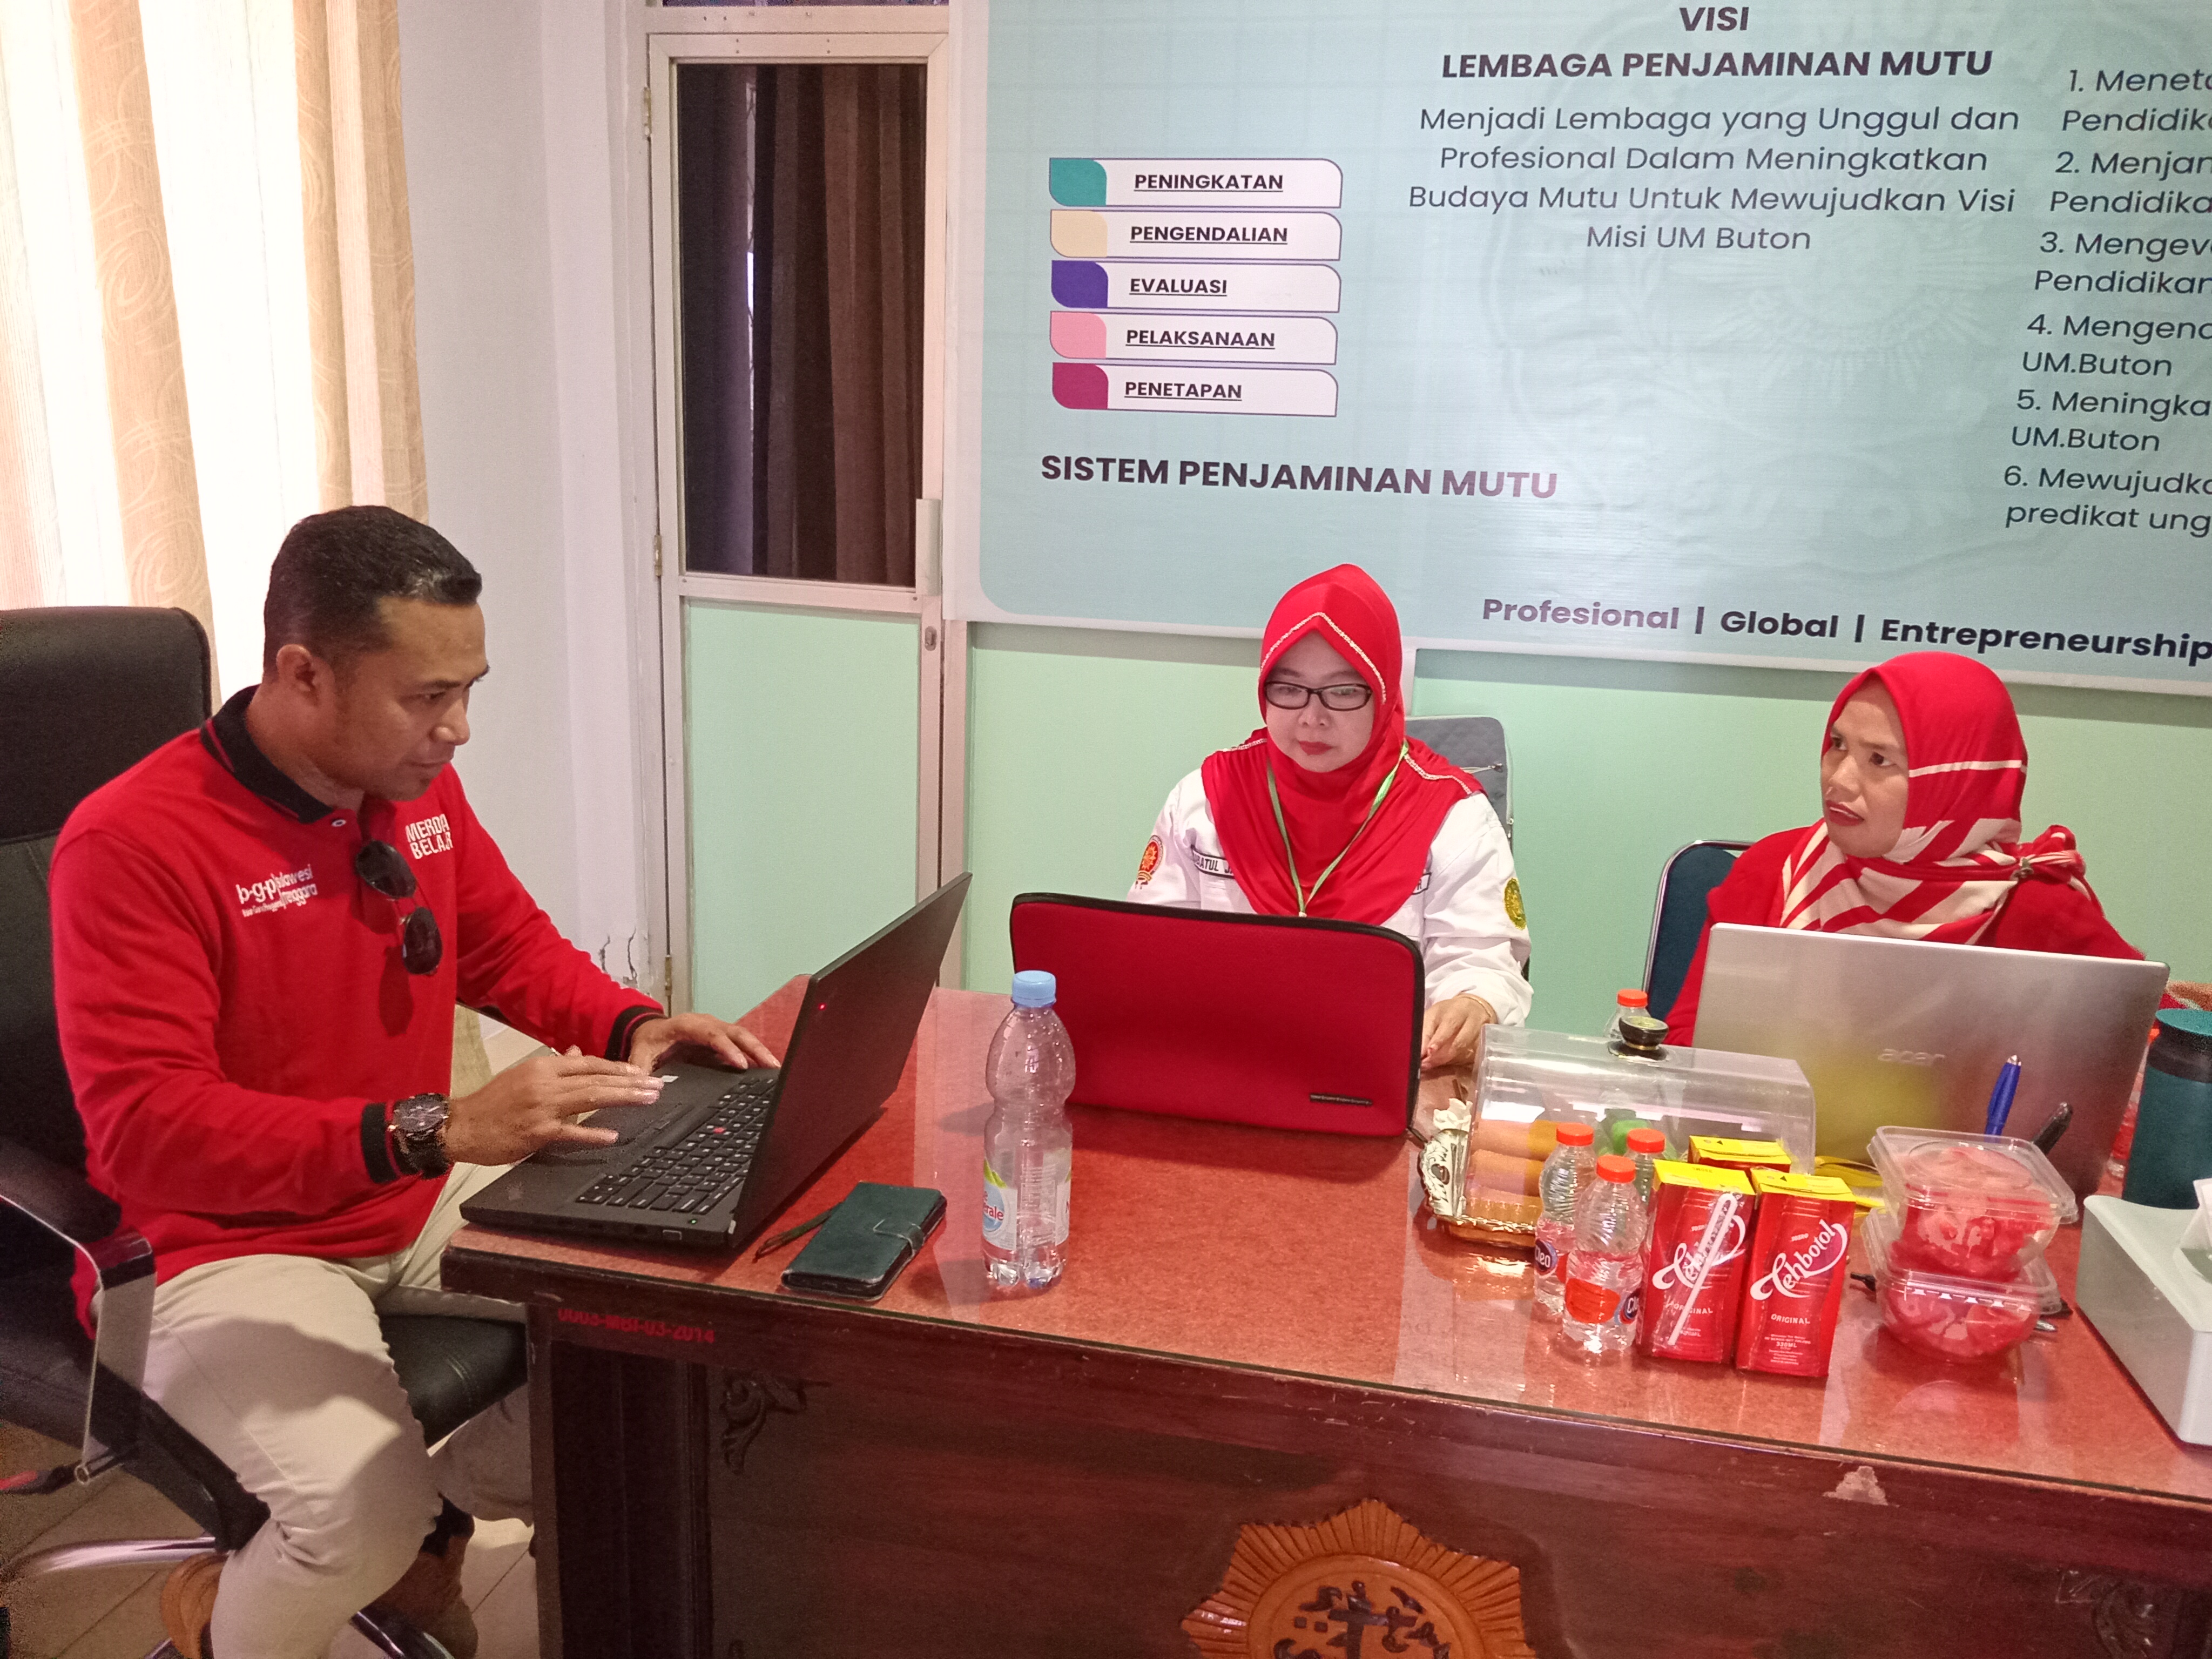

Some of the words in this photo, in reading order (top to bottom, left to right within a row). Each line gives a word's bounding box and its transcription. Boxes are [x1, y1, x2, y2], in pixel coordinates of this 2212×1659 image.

[1679, 6, 1749, 31] VISI
[1442, 53, 1612, 78] LEMBAGA
[1622, 51, 1871, 77] PENJAMINAN
[1880, 50, 1993, 76] MUTU
[2069, 69, 2083, 92] 1.
[1420, 106, 1546, 137] Menjadi
[1555, 106, 1711, 138] Lembaga
[1722, 111, 1807, 138] yang
[1819, 106, 1940, 138] Unggul
[1951, 106, 2019, 130] dan
[2062, 107, 2212, 132] Pendidik
[1441, 145, 1616, 169] Profesional
[1626, 146, 1734, 170] Dalam
[1746, 146, 1987, 178] Meningkatkan
[2055, 151, 2080, 173] 2.
[1134, 174, 1283, 193] PENINGKATAN
[1409, 185, 1528, 215] Budaya
[1539, 187, 1618, 208] Mutu
[1629, 186, 1722, 210] Untuk
[1731, 186, 1945, 218] Mewujudkan
[1958, 188, 2015, 212] Visi
[1130, 226, 1287, 245] PENGENDALIAN
[1587, 225, 1647, 248] Misi
[1657, 226, 1705, 248] UM
[1716, 227, 1811, 249] Buton
[2040, 231, 2064, 253] 3.
[2075, 233, 2212, 263] Mengev
[1129, 278, 1228, 297] EVALUASI
[2027, 314, 2052, 335] 4.
[1125, 329, 1276, 350] PELAKSANAAN
[2022, 351, 2172, 376] UM.Buton
[1124, 381, 1242, 402] PENETAPAN
[2017, 389, 2041, 410] 5.
[2012, 426, 2160, 451] UM.Buton
[1041, 455, 1169, 484] SISTEM
[1179, 460, 1432, 494] PENJAMINAN
[1441, 469, 1557, 498] MUTU
[2004, 465, 2028, 487] 6.
[2005, 504, 2140, 529] predikat
[1482, 598, 1680, 630] Profesional
[1721, 611, 1839, 638] Global
[1880, 619, 2212, 666] Entrepreneurship
[1770, 1313, 1811, 1324] ORIGINAL
